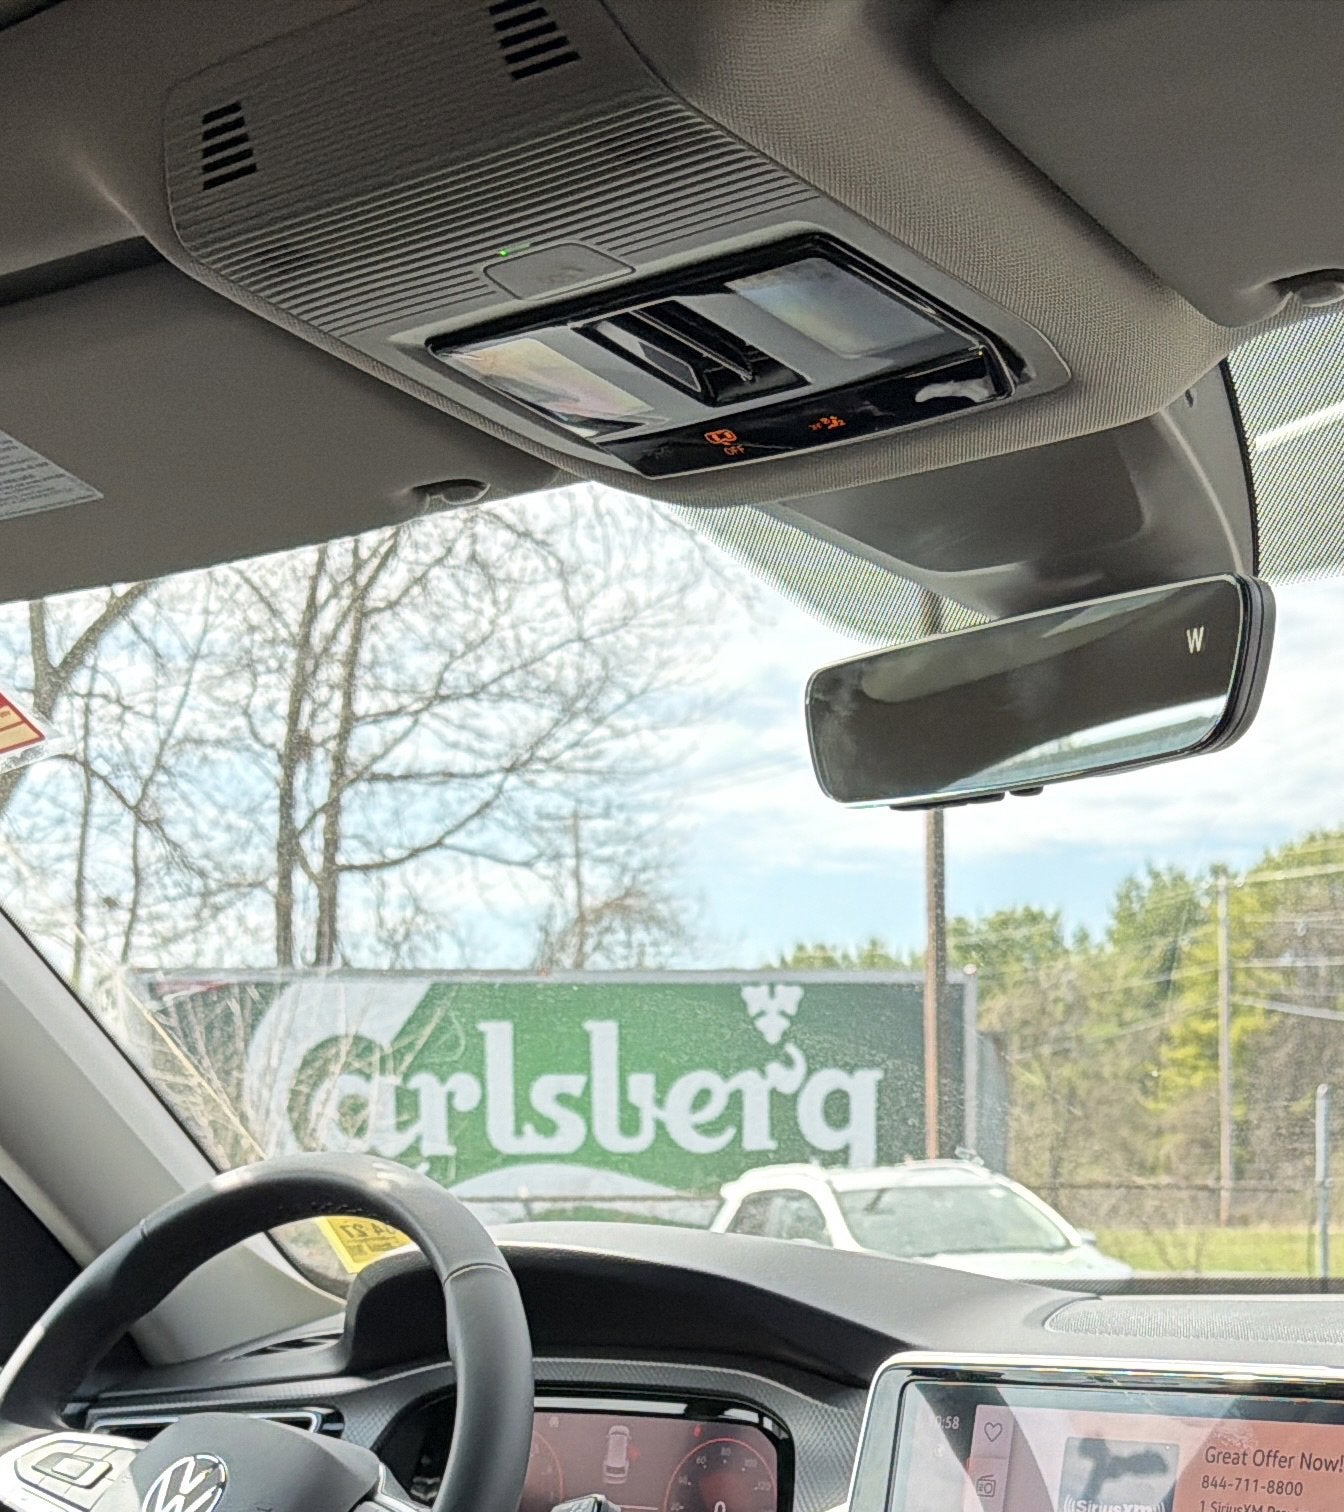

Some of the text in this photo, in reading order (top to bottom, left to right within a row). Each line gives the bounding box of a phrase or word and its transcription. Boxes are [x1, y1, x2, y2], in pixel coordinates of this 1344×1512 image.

[1186, 625, 1205, 654] W
[246, 983, 884, 1182] Carlsberg
[1204, 1446, 1344, 1473] Great Offer Now!
[1201, 1475, 1304, 1496] 844-711-8800
